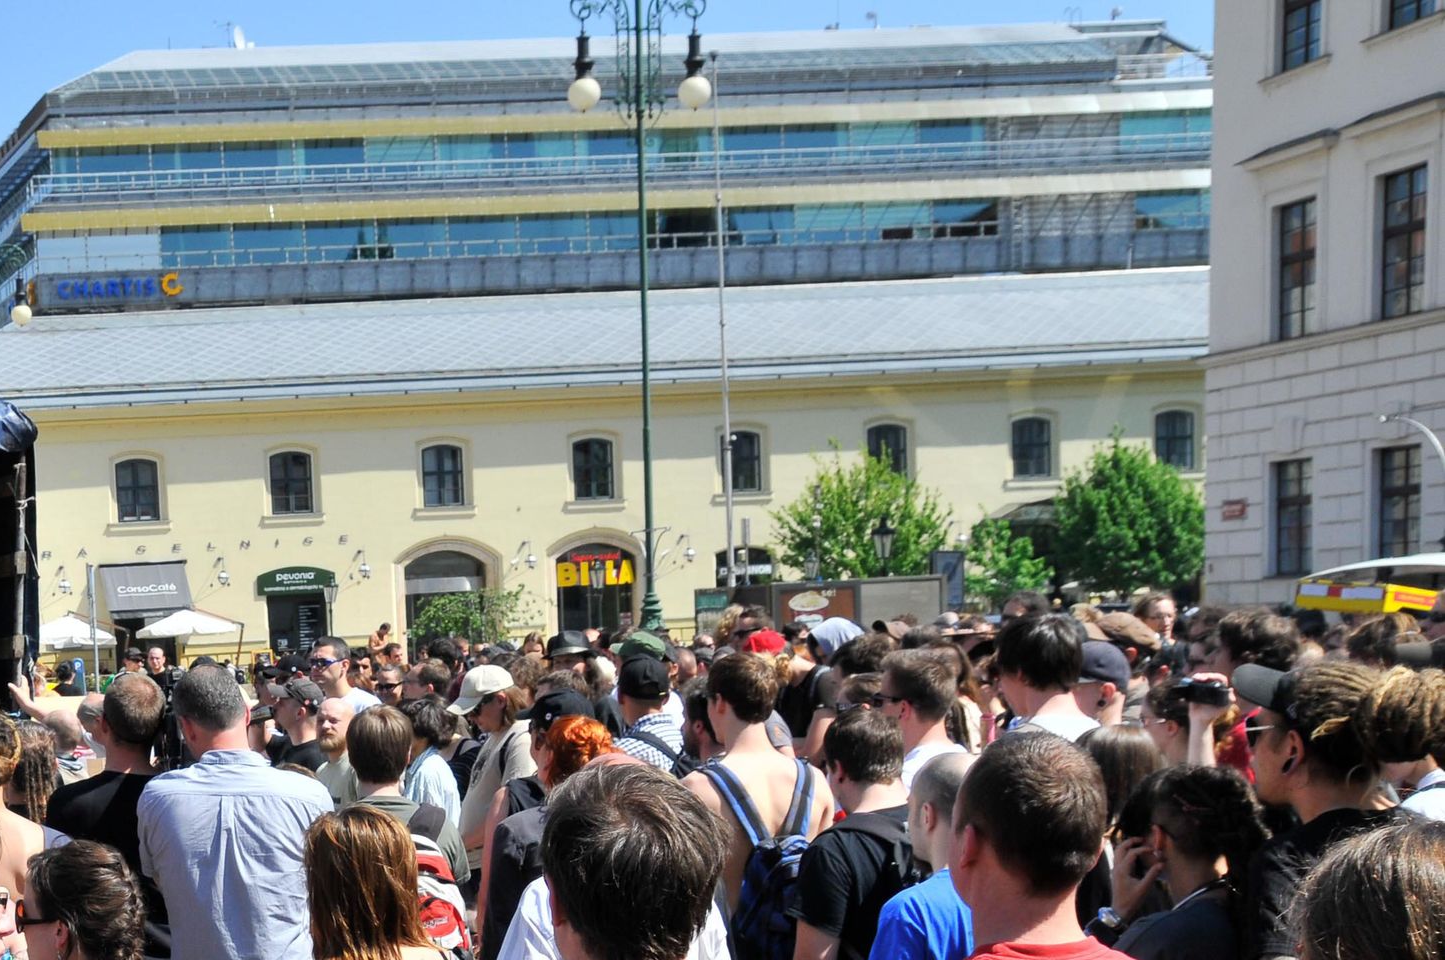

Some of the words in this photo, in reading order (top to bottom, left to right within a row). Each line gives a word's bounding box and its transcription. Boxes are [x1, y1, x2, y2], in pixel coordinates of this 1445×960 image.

[57, 275, 157, 299] CHARTIS
[275, 572, 315, 582] pevonia
[557, 560, 635, 587] BILA
